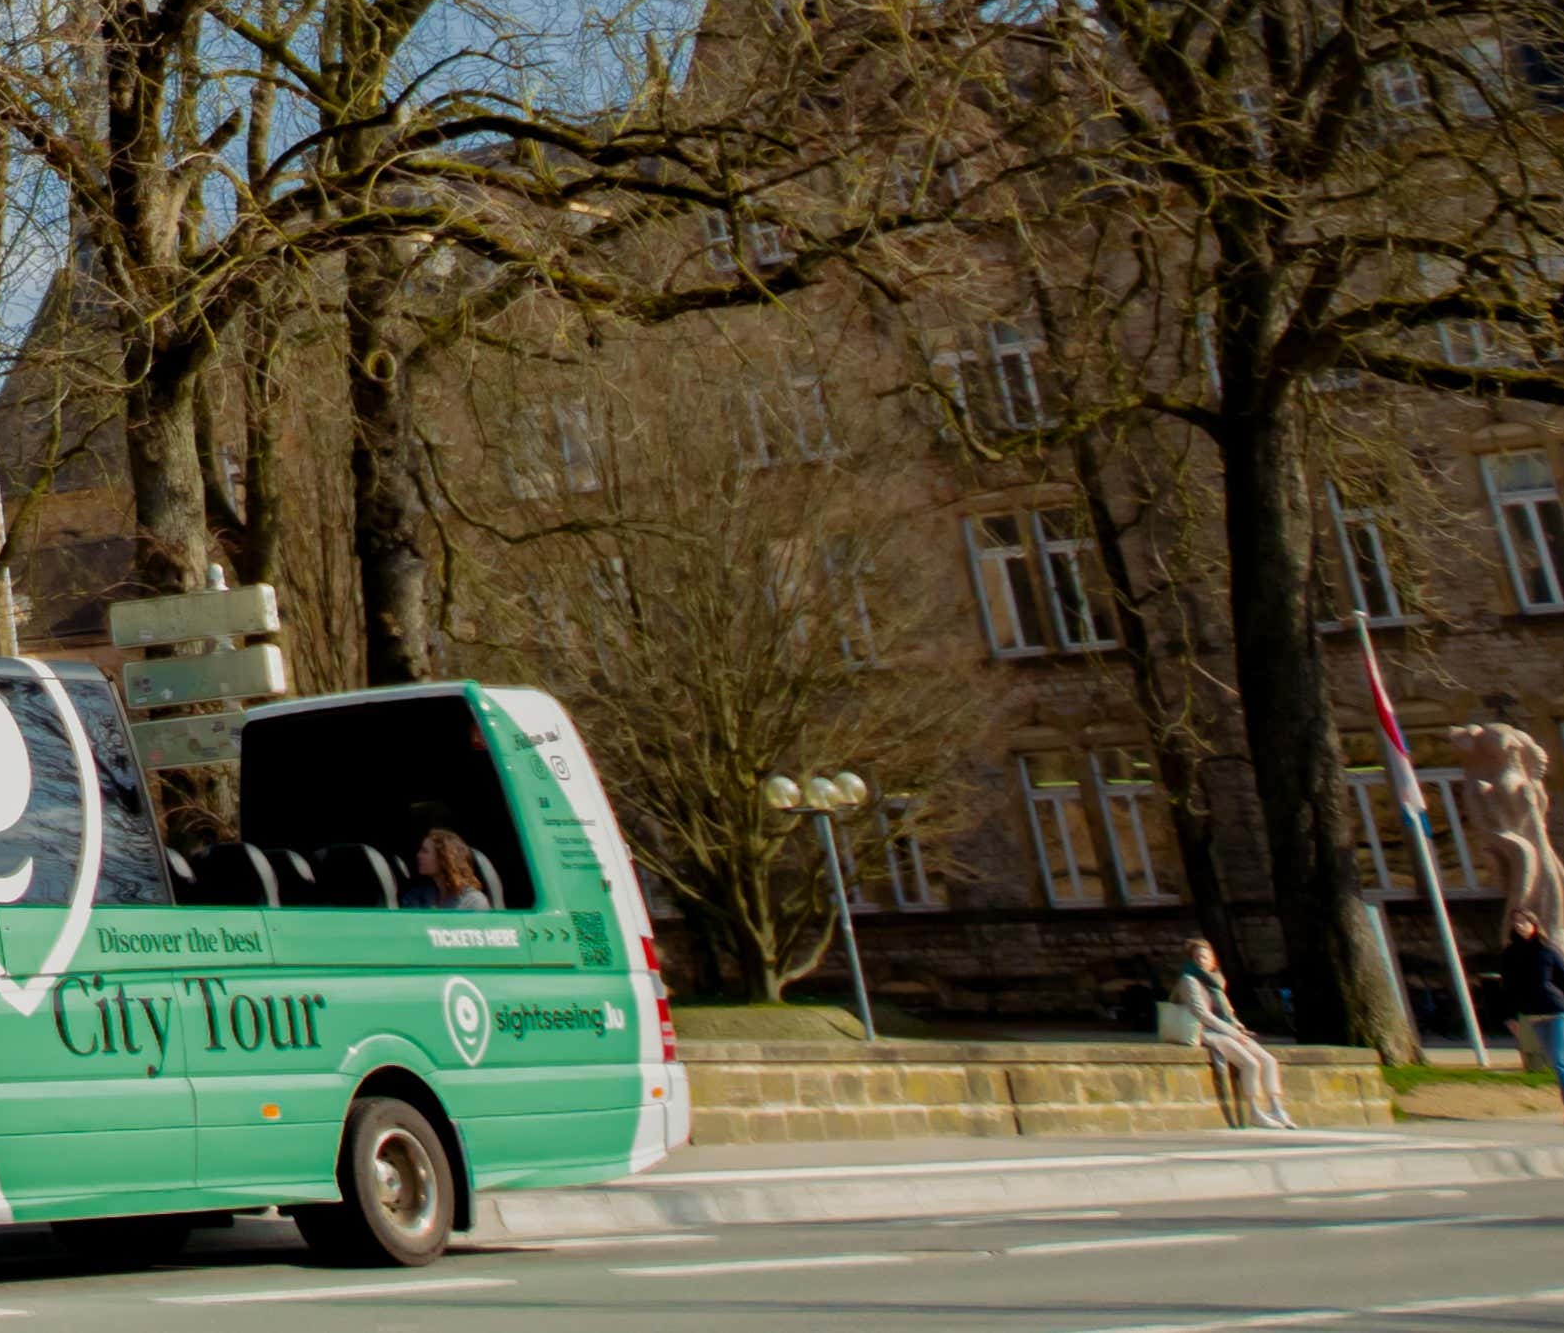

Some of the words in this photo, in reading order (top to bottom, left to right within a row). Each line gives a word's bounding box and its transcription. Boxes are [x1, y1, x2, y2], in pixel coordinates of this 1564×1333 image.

[96, 927, 181, 954] Discover
[186, 927, 218, 953] the
[220, 928, 264, 953] best
[427, 929, 485, 947] TICKETS
[485, 929, 520, 947] HERE
[53, 973, 173, 1079] City
[183, 976, 327, 1052] Tour
[495, 1000, 625, 1040] sightseeing.lu
